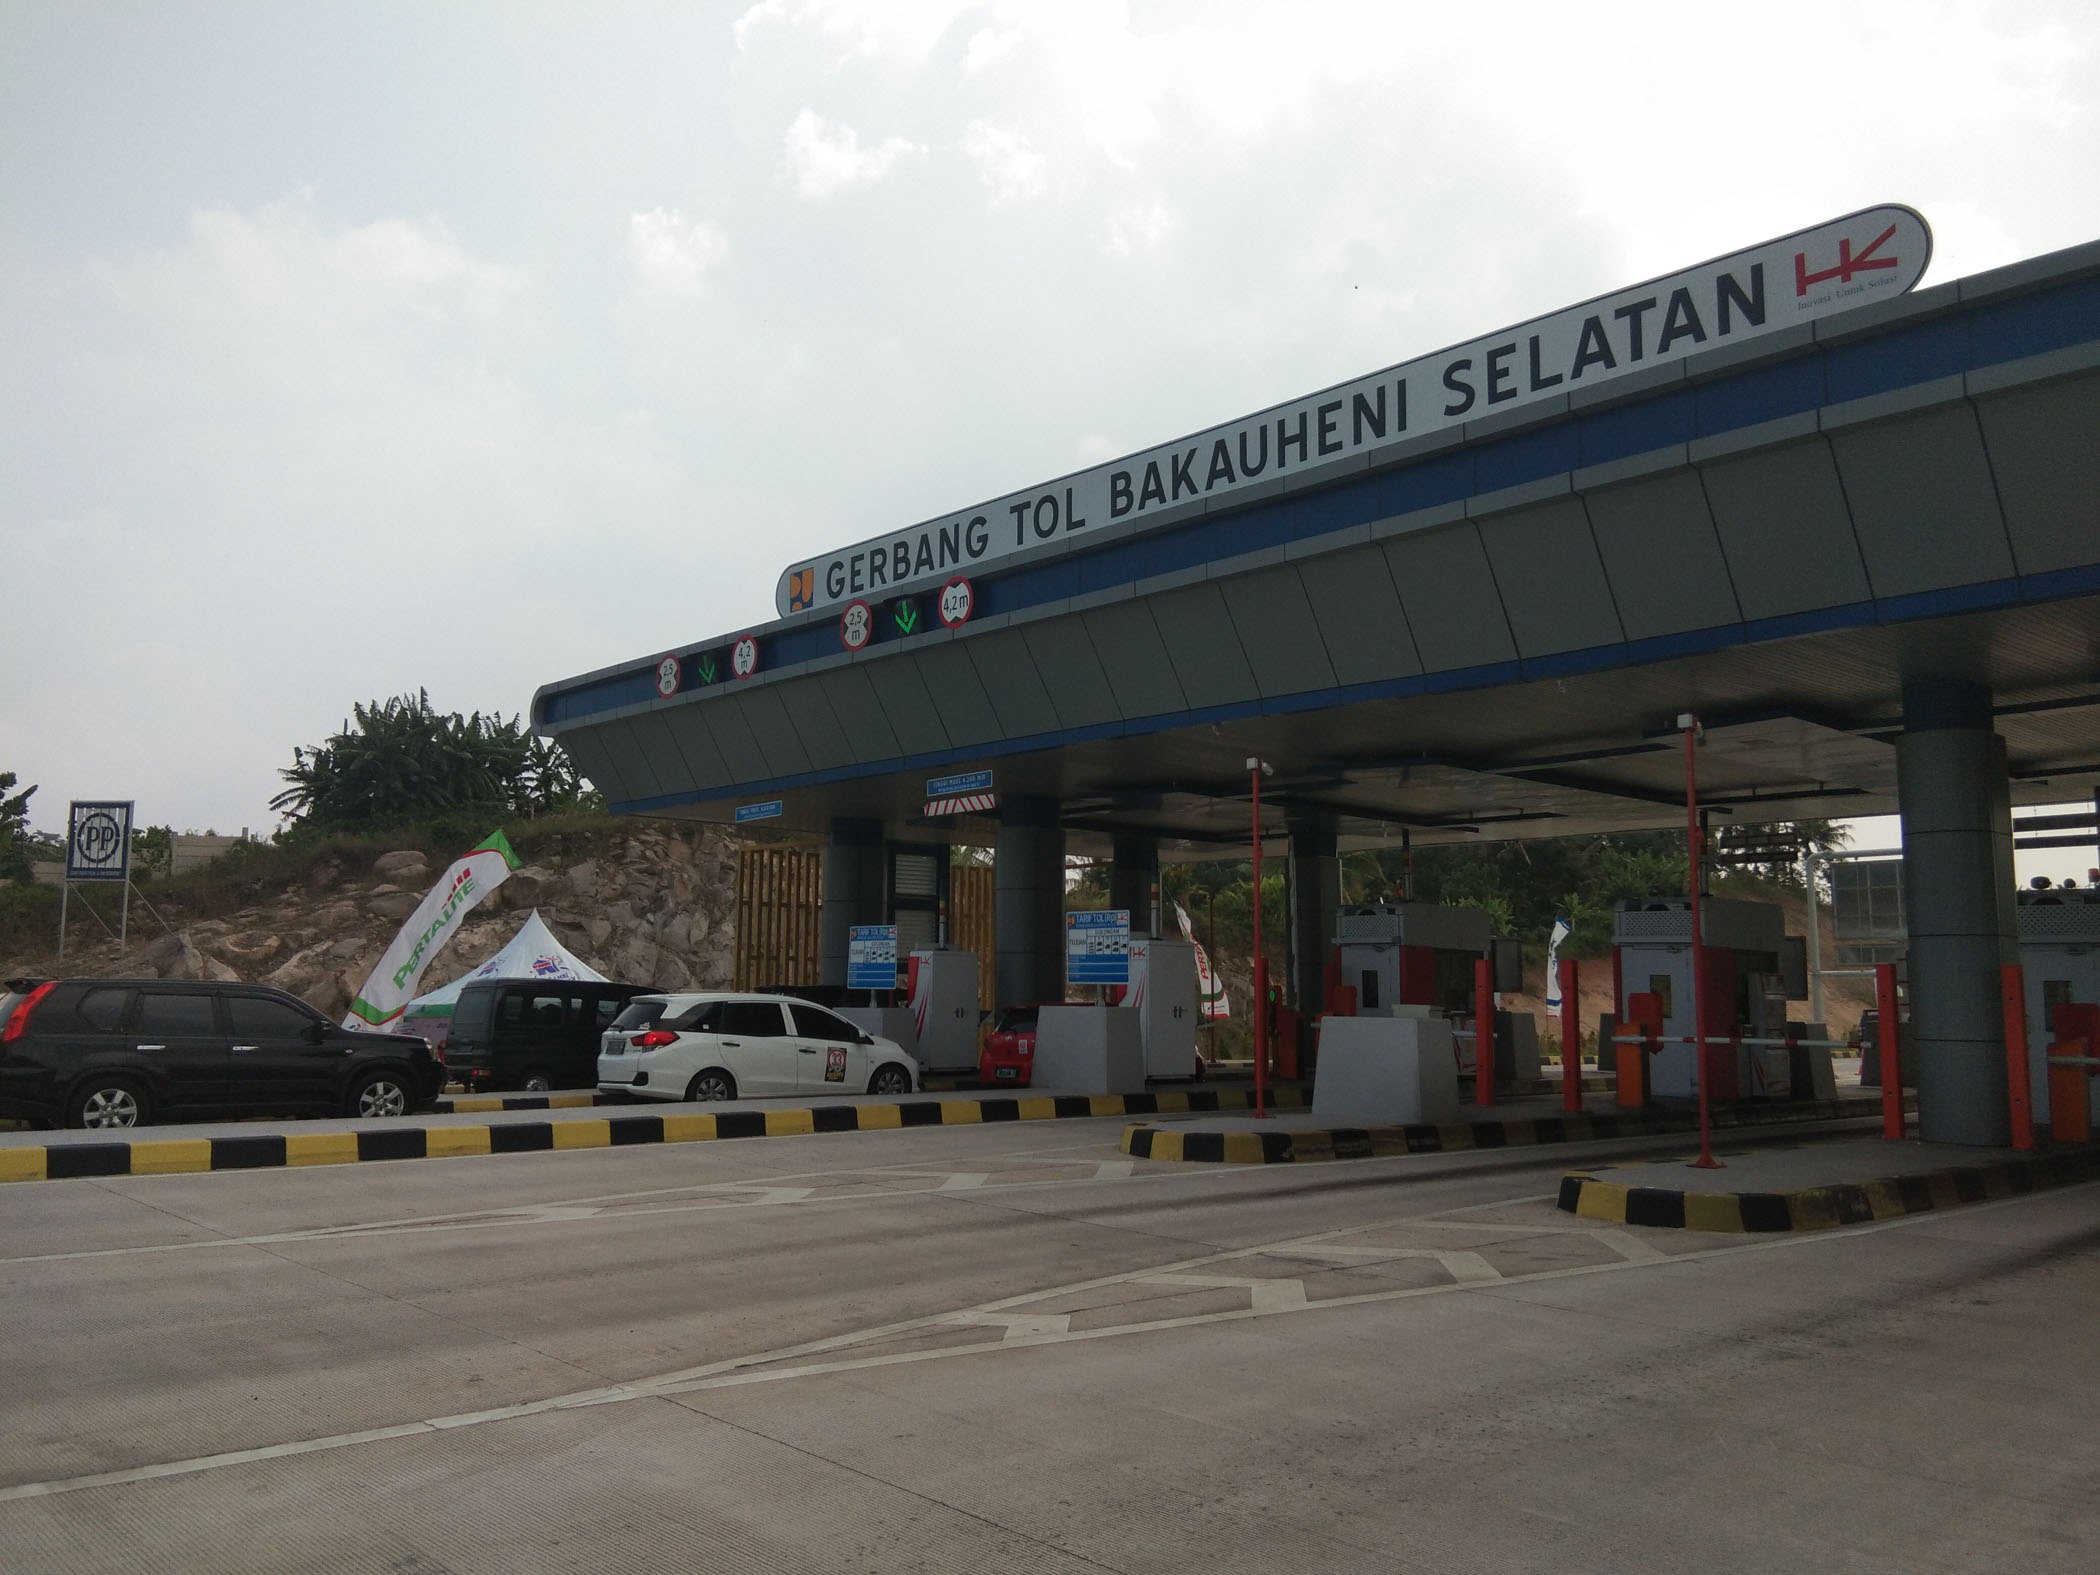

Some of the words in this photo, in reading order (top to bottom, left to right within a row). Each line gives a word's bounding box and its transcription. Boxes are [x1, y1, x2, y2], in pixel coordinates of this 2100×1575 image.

[1795, 223, 1898, 297] HK
[1836, 284, 1865, 299] Untuk
[826, 516, 988, 599] GERBANG
[1010, 488, 1086, 545] TOL
[1110, 379, 1407, 518] BAKAUHENI
[1443, 262, 1766, 416] SELATAN
[943, 595, 957, 613] 4,2
[959, 595, 969, 608] m
[849, 611, 862, 626] 2,5
[851, 629, 860, 640] m
[738, 646, 751, 658] 4,2
[663, 664, 673, 676] 2,5
[740, 660, 748, 668] m
[664, 680, 672, 690] m
[85, 826, 115, 851] PP
[1076, 913, 1091, 923] TARIF
[1093, 913, 1104, 922] TOL
[392, 878, 475, 990] PERTALITE
[832, 1053, 842, 1066] 33
